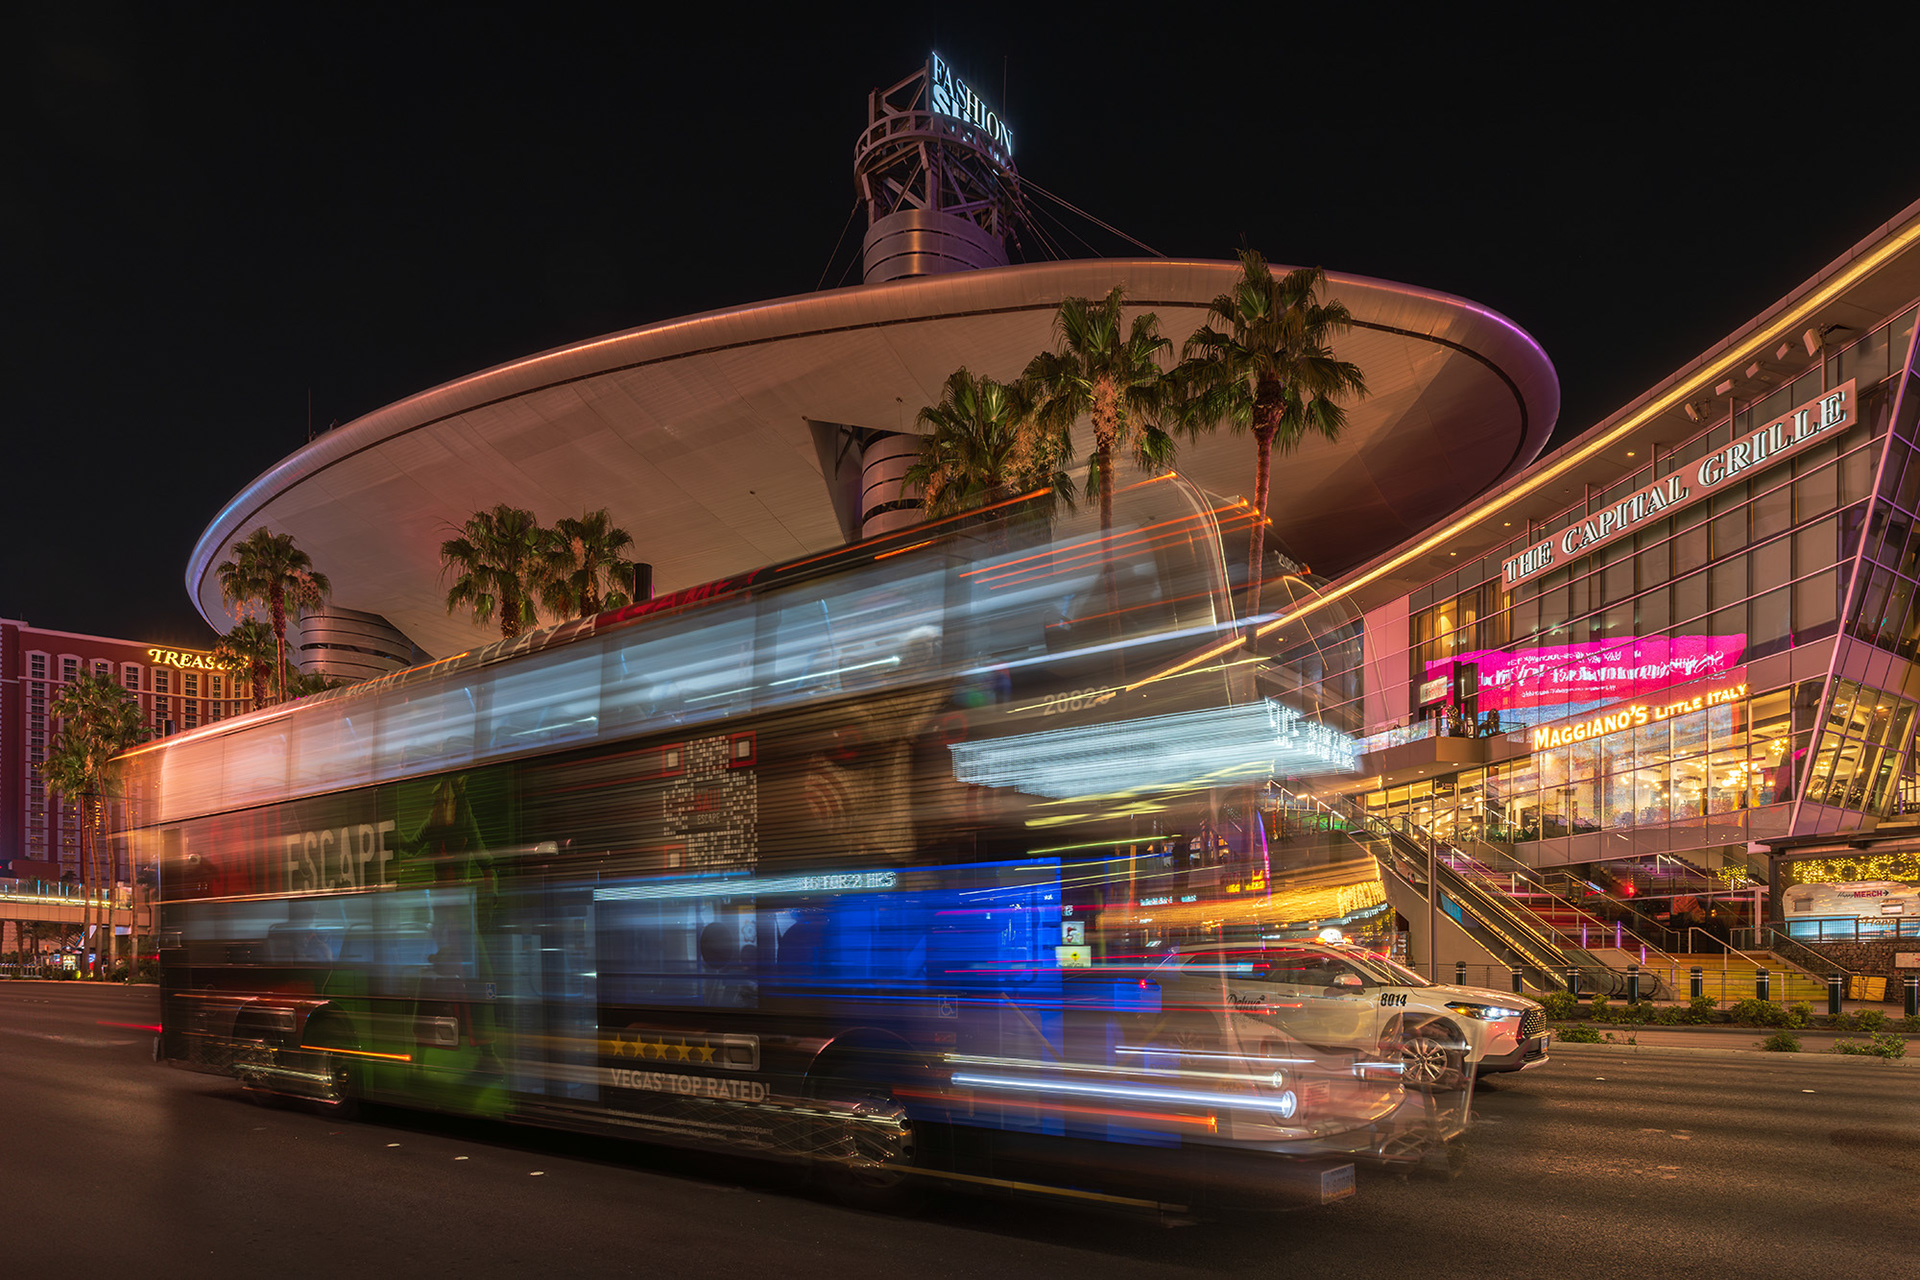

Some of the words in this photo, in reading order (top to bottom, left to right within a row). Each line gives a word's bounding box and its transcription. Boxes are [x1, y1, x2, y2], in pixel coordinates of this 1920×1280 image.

[932, 51, 1013, 156] FASHION
[1504, 540, 1555, 583] THE
[1562, 475, 1689, 555] CAPITAL
[1697, 390, 1847, 487] GRILLE
[1534, 705, 1648, 750] MAGGIANO'S
[1655, 696, 1701, 720] LITTLE
[1707, 684, 1747, 705] ITALY
[286, 819, 397, 894] ESCAPE
[867, 872, 896, 888] HRS
[1854, 890, 1883, 898] MERCH
[1380, 992, 1407, 1007] 8014
[611, 1068, 666, 1093] VEGAS'
[669, 1074, 701, 1094] TOP
[708, 1077, 771, 1103] RATED!
